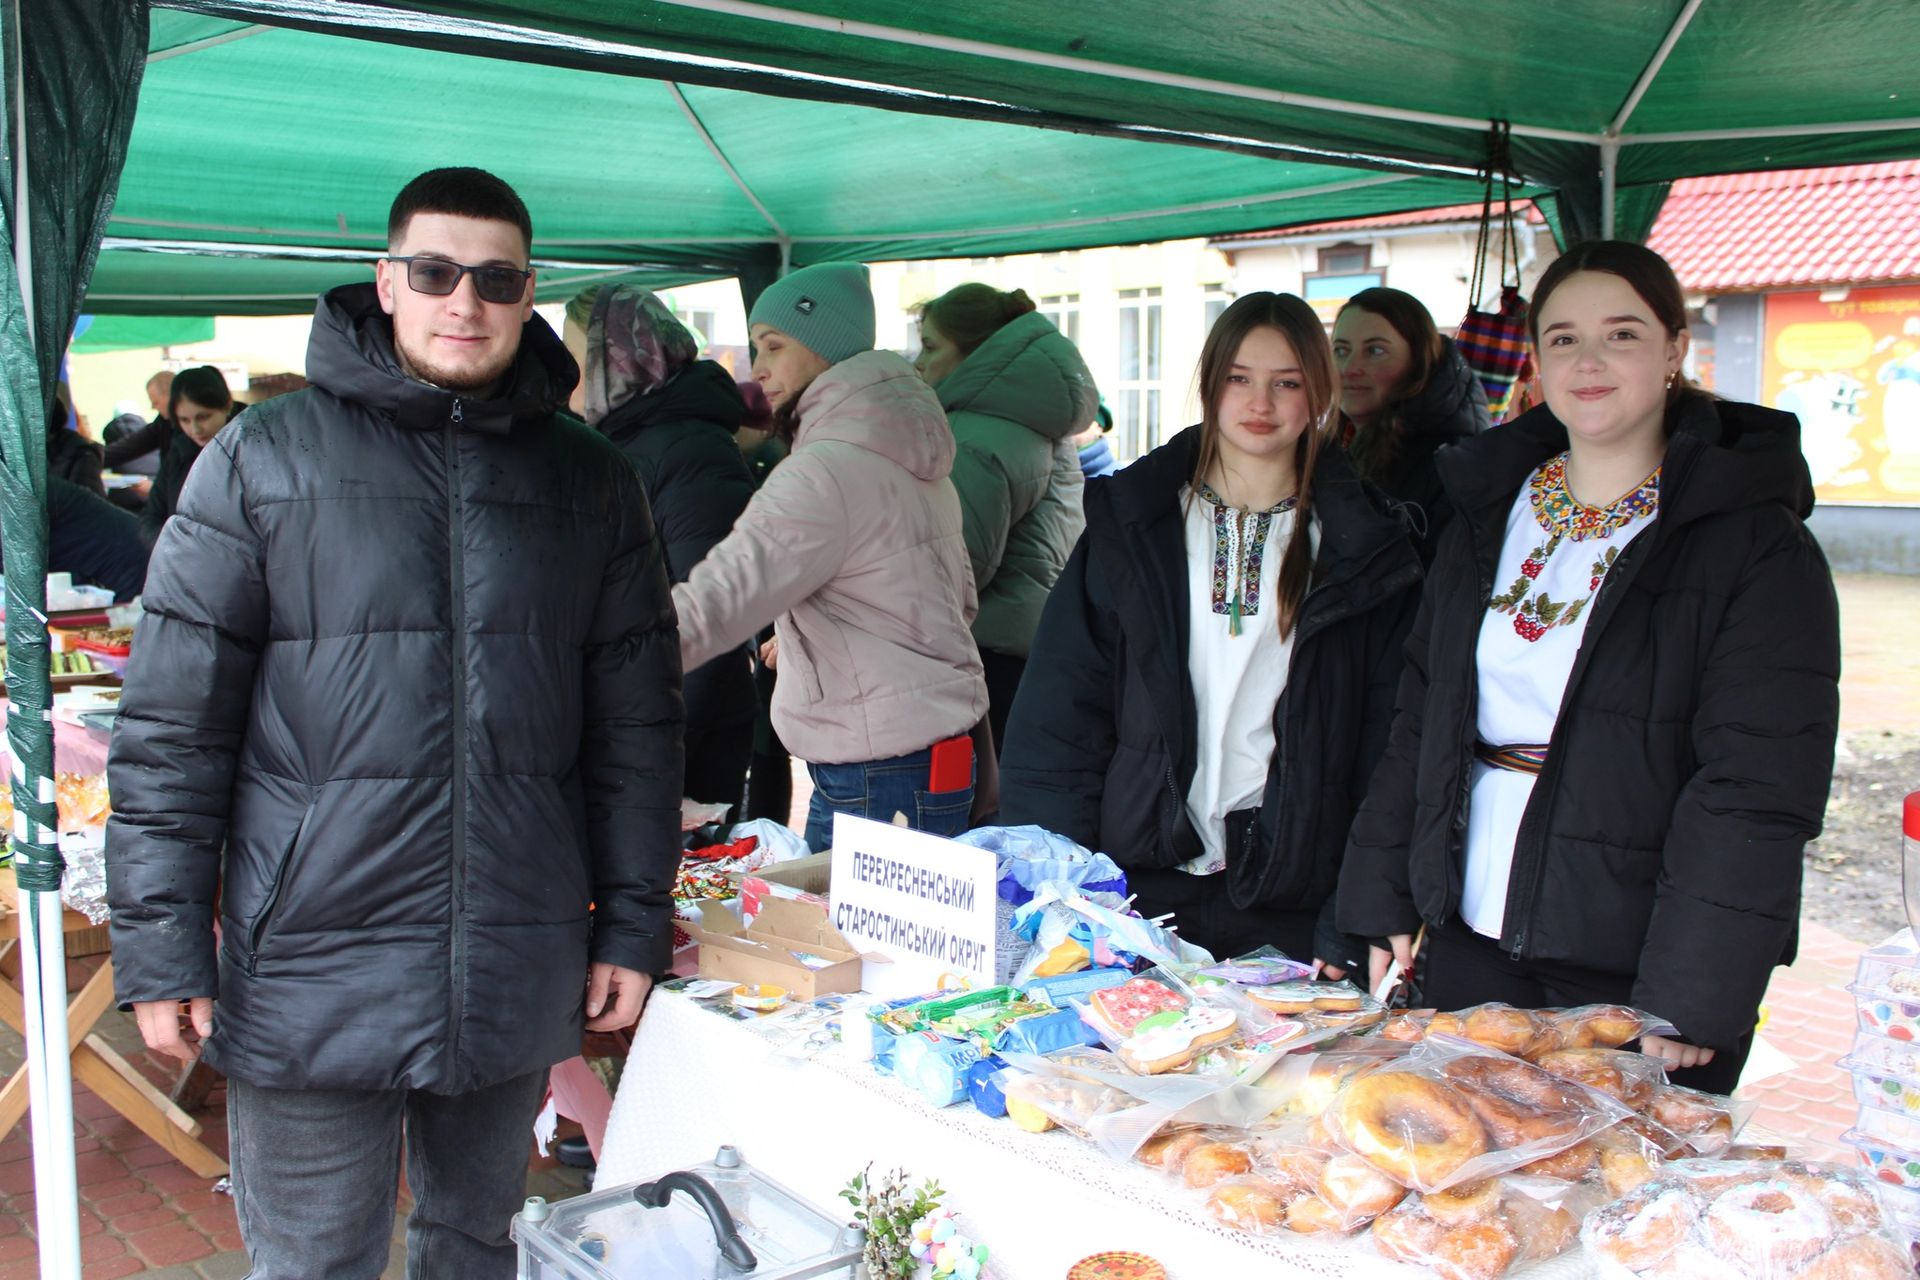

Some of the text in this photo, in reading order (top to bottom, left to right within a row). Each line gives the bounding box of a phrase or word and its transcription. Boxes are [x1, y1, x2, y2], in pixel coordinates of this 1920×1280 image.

[853, 851, 974, 912] ПЕРЕХРЕСНЕНСЬКИЙ
[837, 902, 946, 960] СТАРОСТИНСЬКИЙ
[951, 935, 986, 972] ОКРУГ
